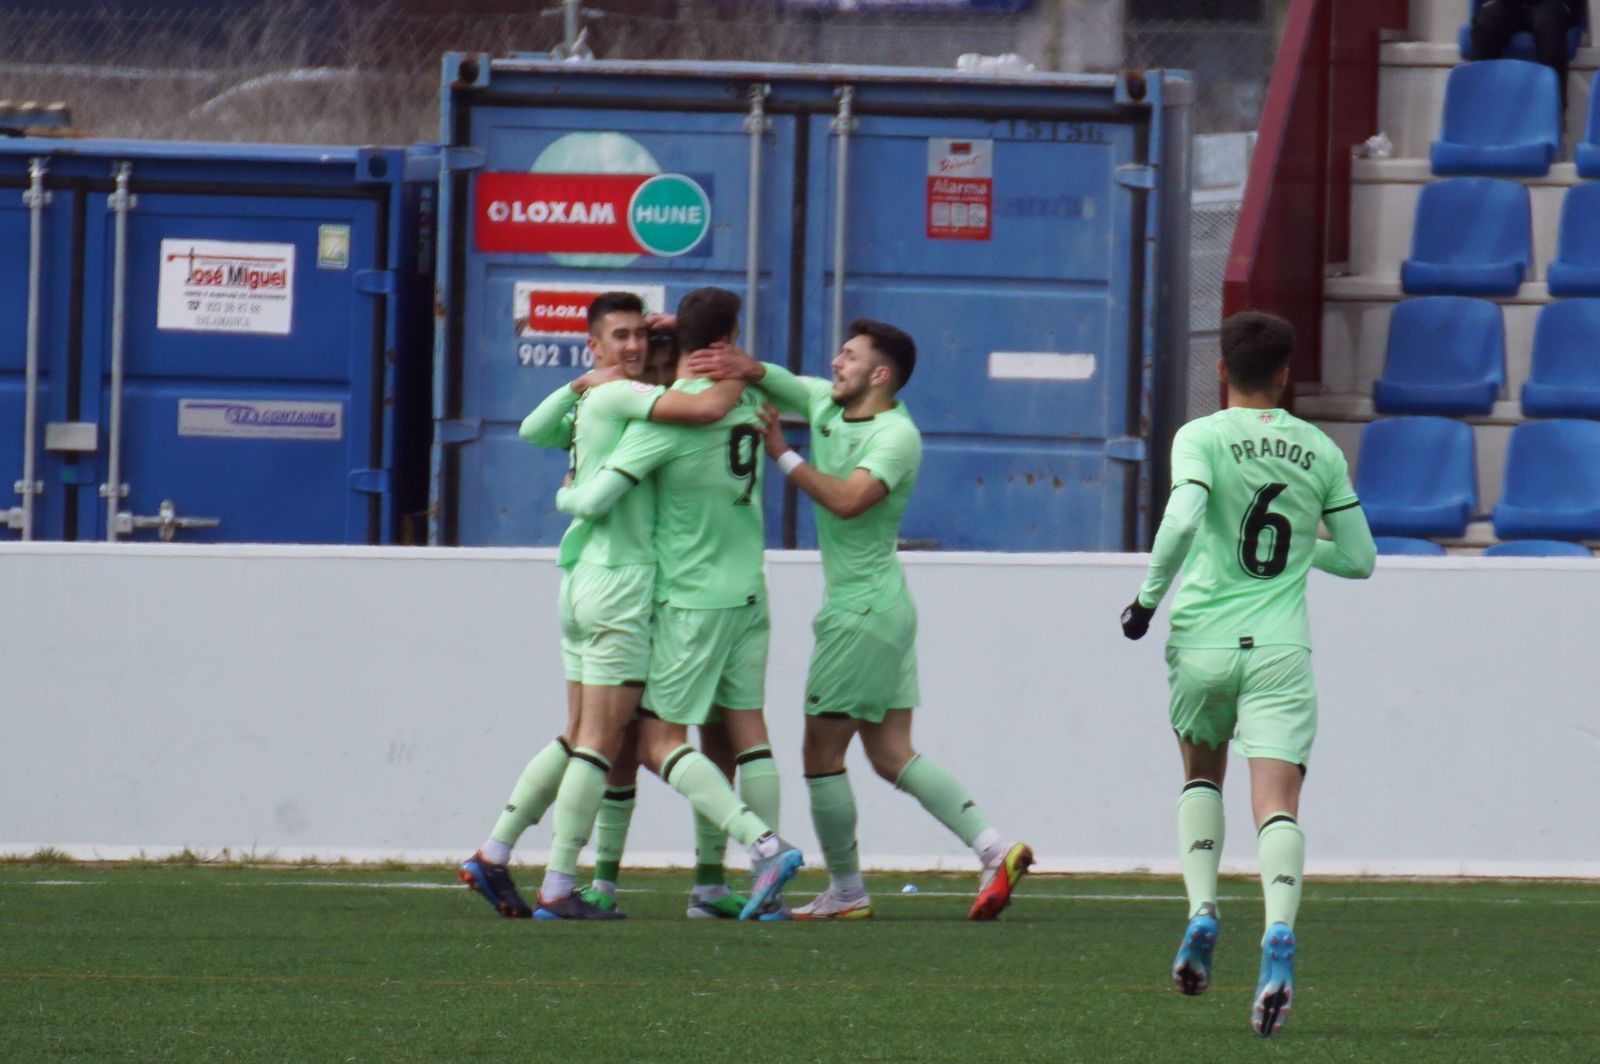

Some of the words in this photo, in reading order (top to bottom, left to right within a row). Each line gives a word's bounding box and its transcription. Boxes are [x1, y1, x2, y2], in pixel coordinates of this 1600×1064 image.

[636, 204, 703, 225] HUNE
[227, 266, 287, 291] Miguel
[546, 304, 588, 318] LOXA
[519, 343, 560, 366] 902
[726, 423, 760, 506] 9
[1230, 437, 1316, 471] PRADOS
[1237, 482, 1292, 580] 6
